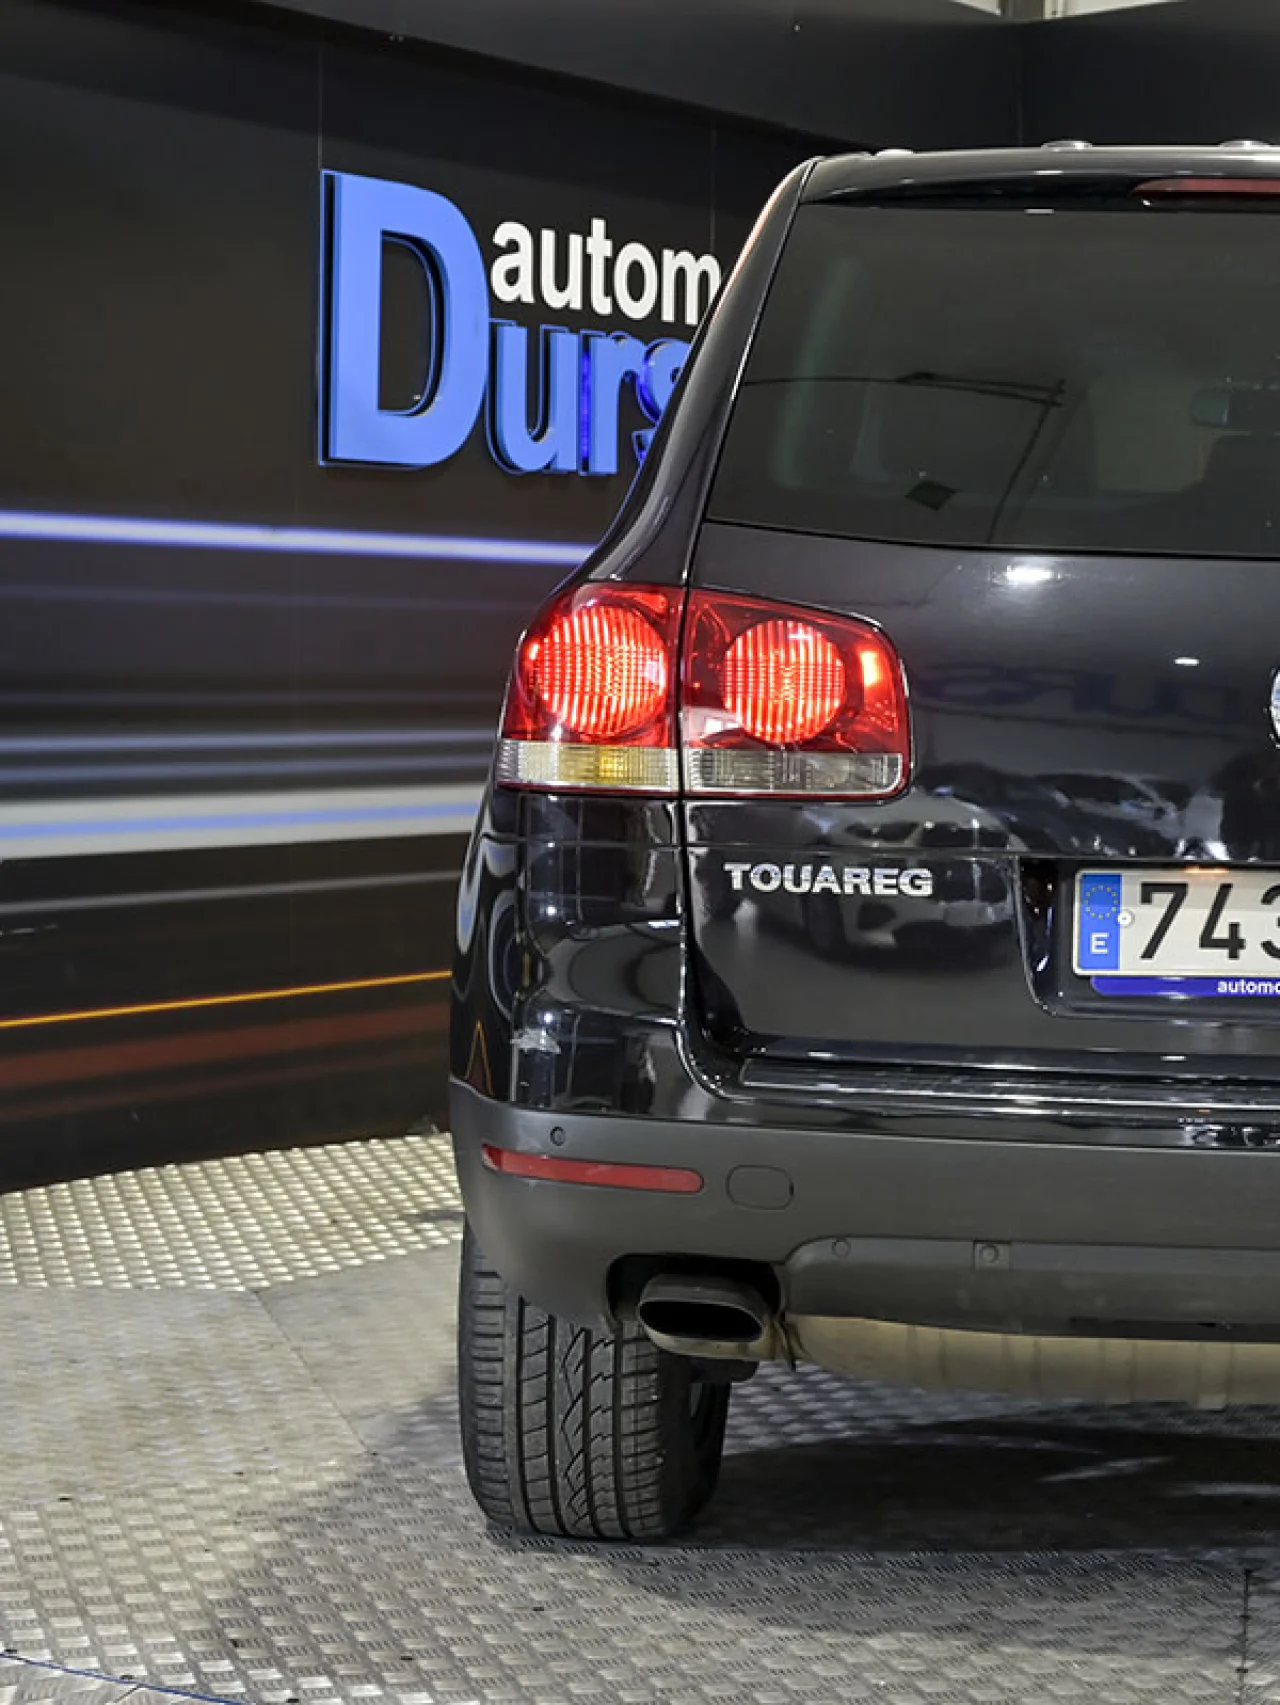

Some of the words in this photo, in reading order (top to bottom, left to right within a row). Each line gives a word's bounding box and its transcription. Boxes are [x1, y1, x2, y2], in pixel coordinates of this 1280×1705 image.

[490, 217, 722, 325] autom
[723, 862, 933, 897] TOUAREG
[1090, 931, 1109, 956] E
